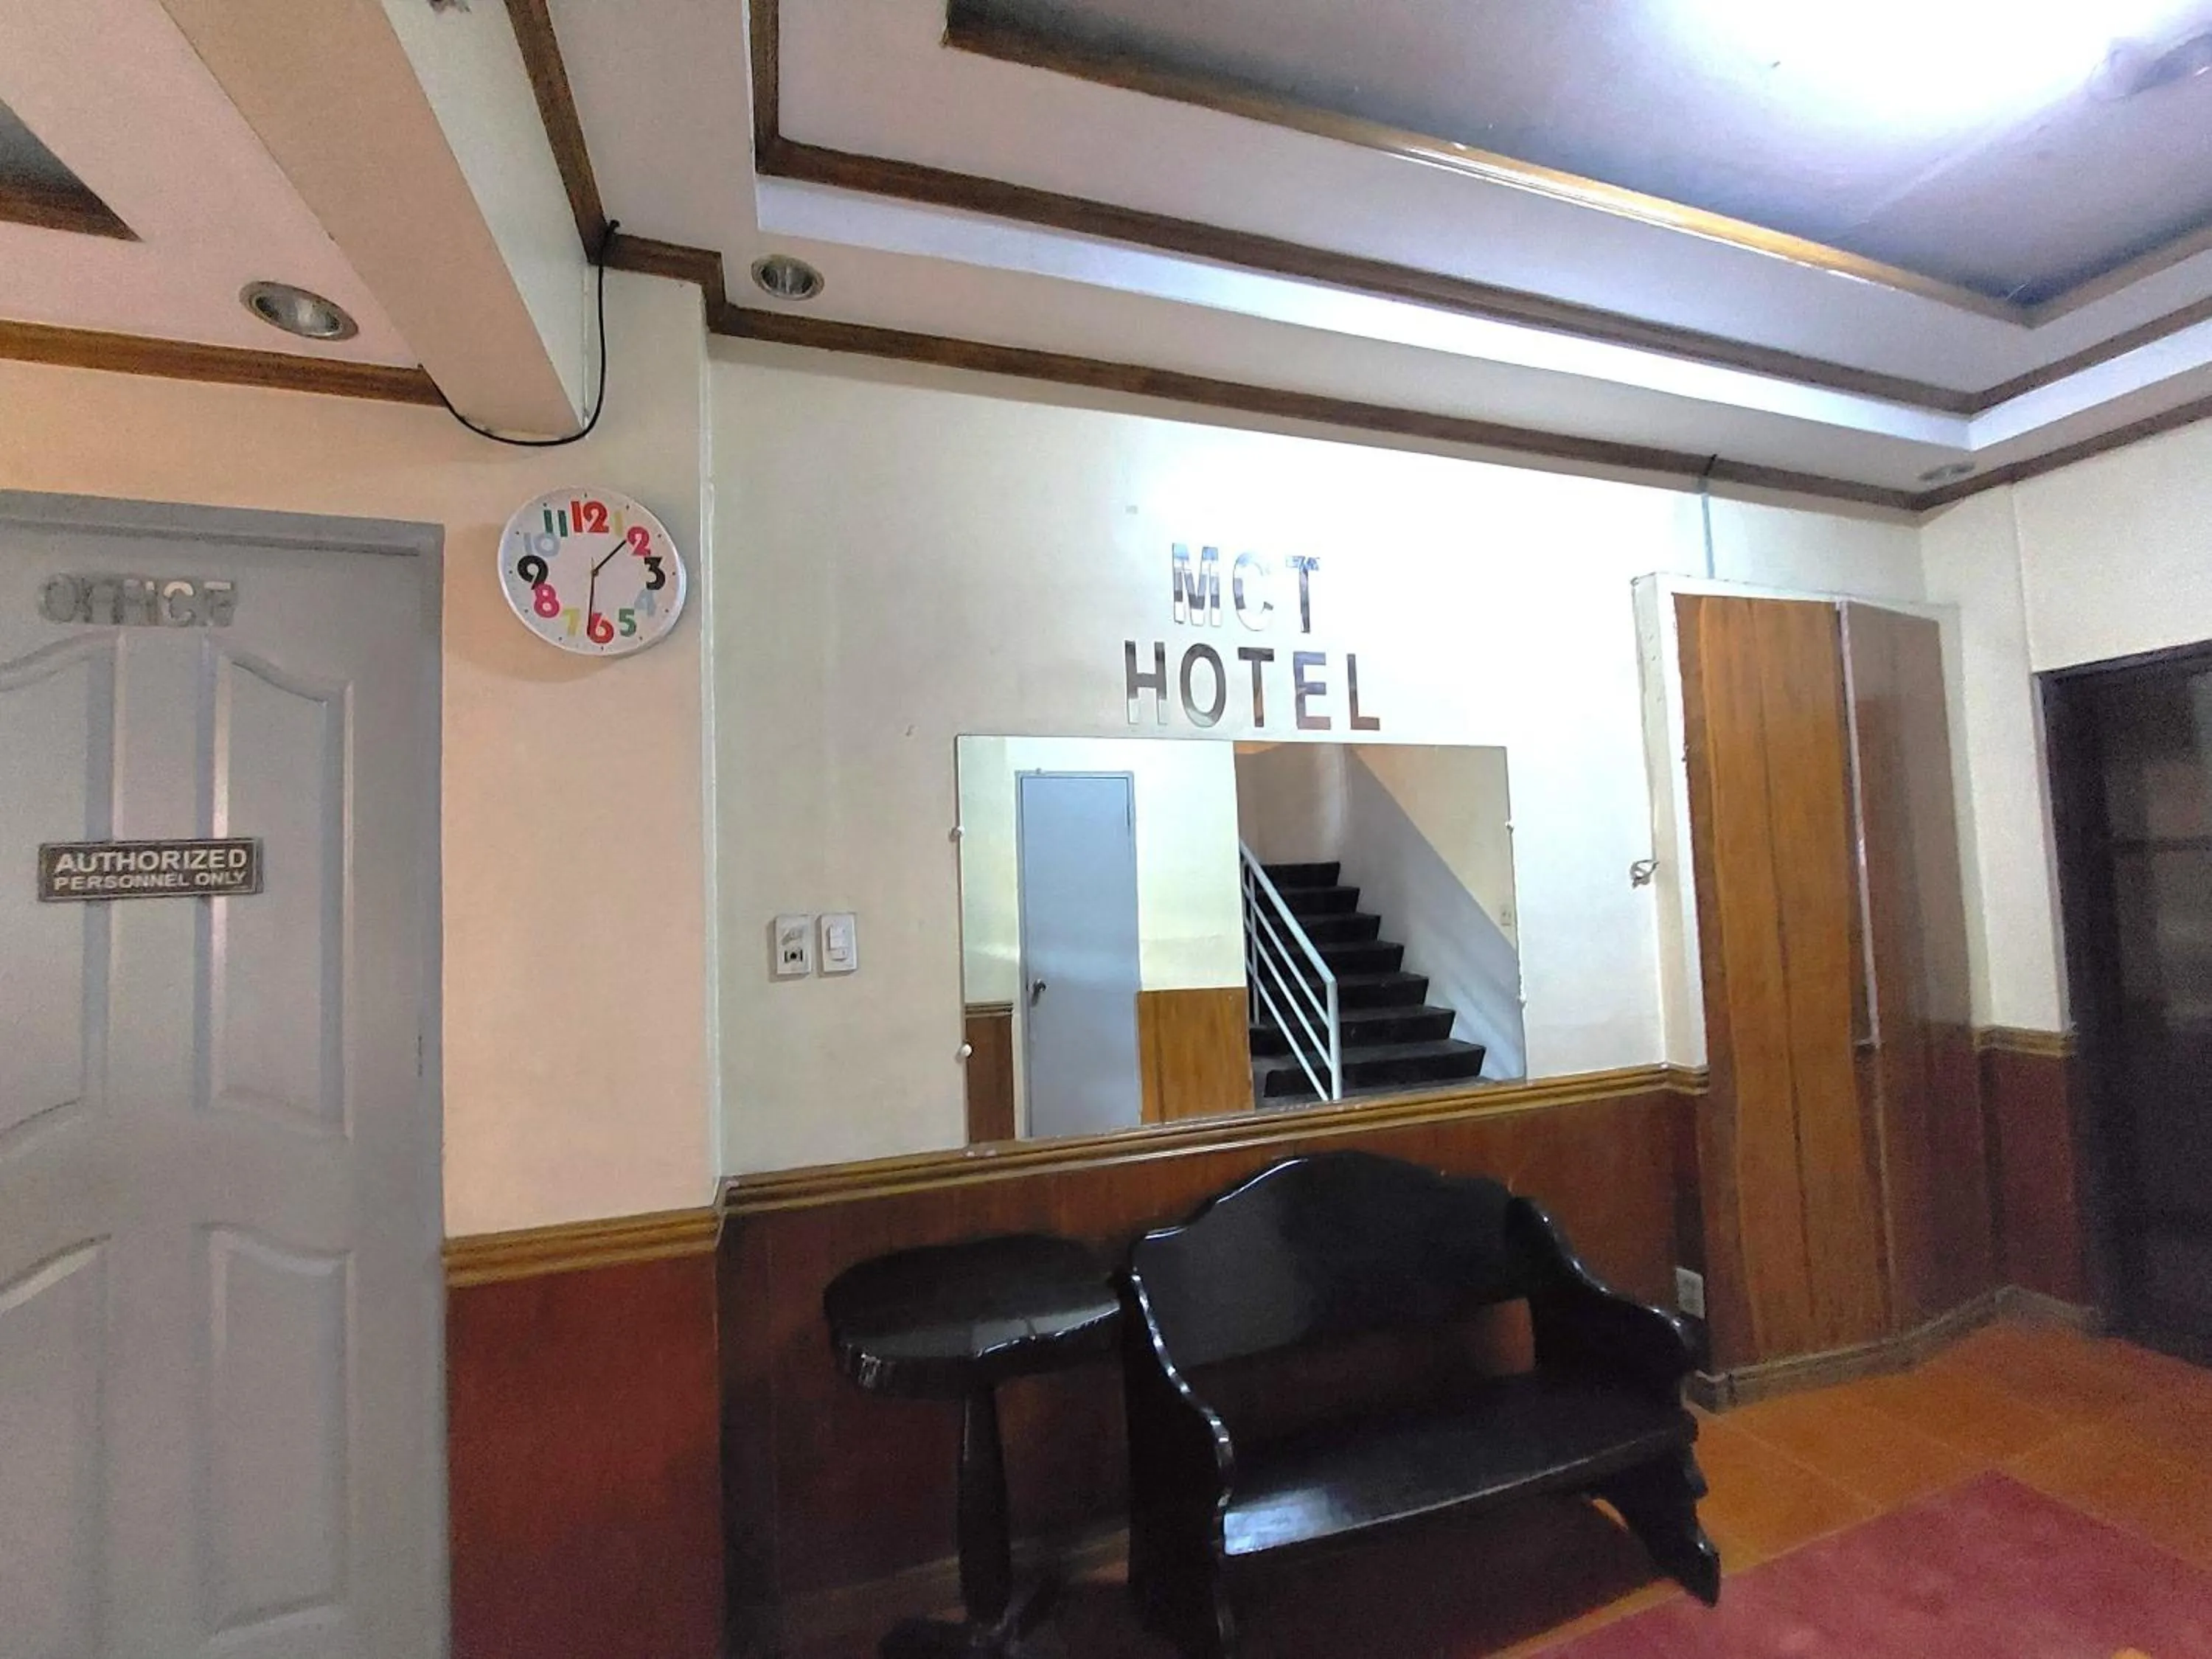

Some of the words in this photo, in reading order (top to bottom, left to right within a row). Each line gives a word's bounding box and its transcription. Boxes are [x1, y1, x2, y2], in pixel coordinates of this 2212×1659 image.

[543, 509, 568, 538] 11
[570, 501, 609, 533] 12
[524, 532, 560, 557] 10
[627, 526, 650, 556] 2
[518, 555, 549, 590] 9
[644, 557, 666, 590] 3
[534, 583, 560, 618] 8
[634, 589, 655, 616] 4
[1172, 542, 1321, 634] MCT
[563, 608, 580, 636] 7
[589, 613, 614, 644] 6
[618, 608, 636, 637] 5
[1124, 639, 1381, 731] HOTEL
[54, 848, 247, 874] AUTHORIZED
[54, 874, 189, 890] PERSONNEL
[195, 870, 247, 886] ONLY
